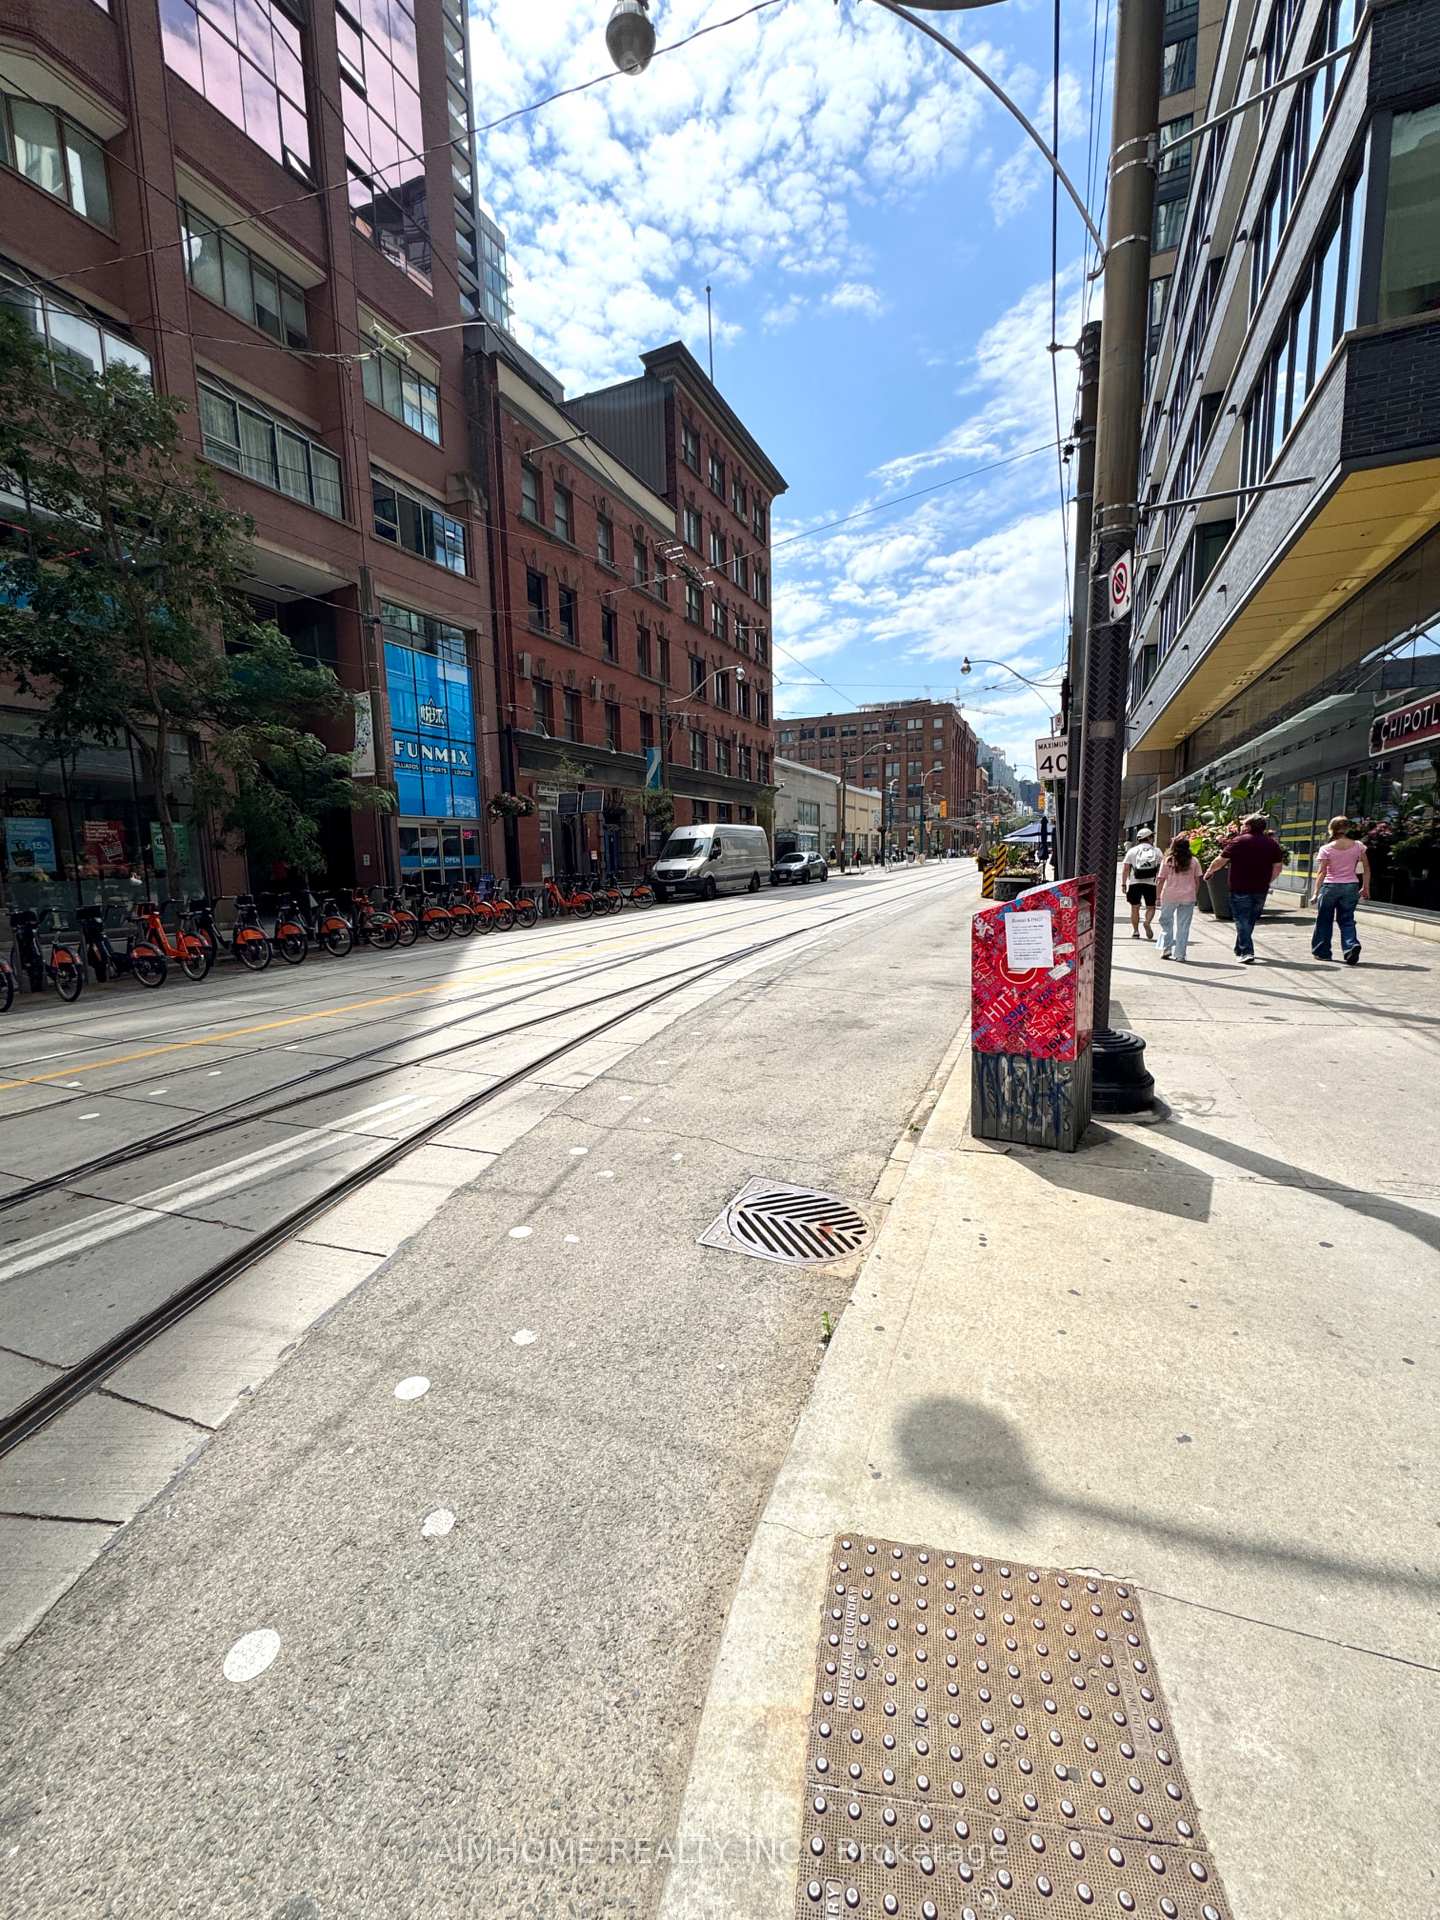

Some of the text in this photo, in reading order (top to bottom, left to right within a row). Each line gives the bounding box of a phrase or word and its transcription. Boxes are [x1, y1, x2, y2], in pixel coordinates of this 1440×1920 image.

[394, 740, 470, 766] FUNMIX
[1039, 754, 1068, 773] 40
[838, 1588, 859, 1709] NEENAH FOUNDRY
[827, 1884, 840, 1920] RY
